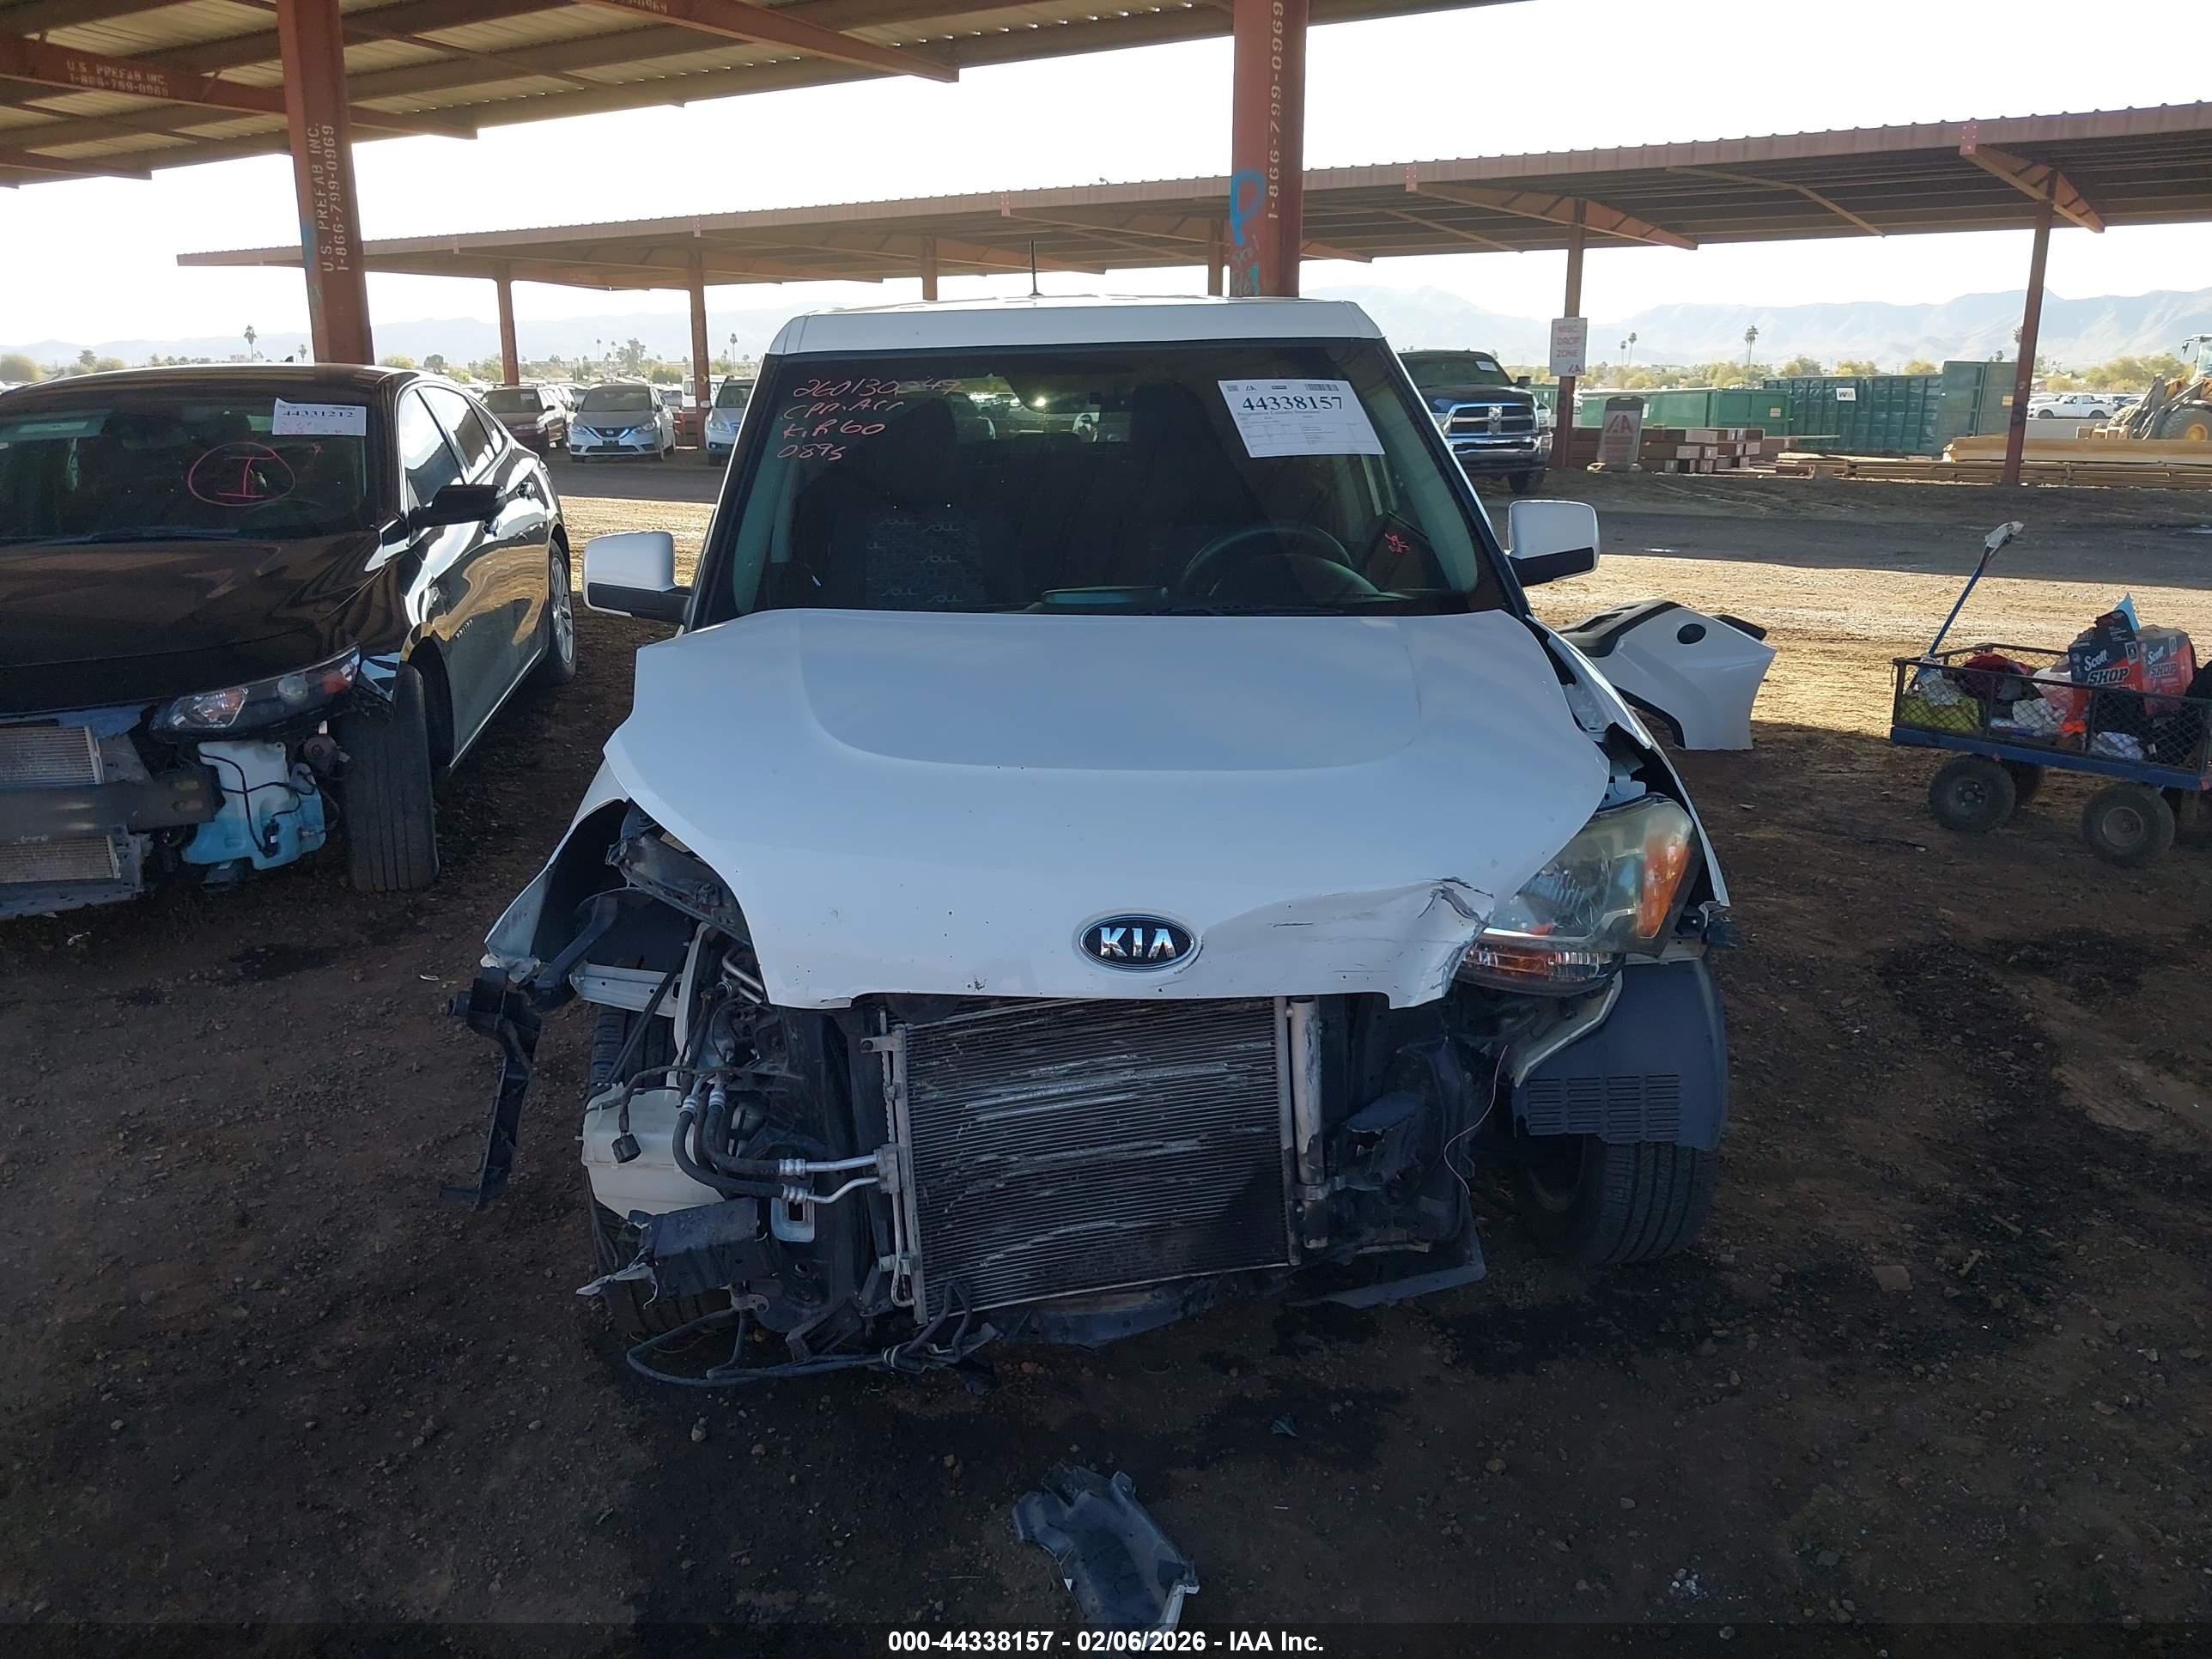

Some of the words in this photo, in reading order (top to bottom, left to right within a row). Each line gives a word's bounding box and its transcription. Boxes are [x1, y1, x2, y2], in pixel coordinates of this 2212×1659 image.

[95, 64, 143, 82] PREFAB
[307, 123, 323, 155] INC.
[311, 164, 331, 230] PREFAB
[321, 125, 350, 271] 1-866-799-0969
[1555, 349, 1579, 358] ZONE
[1243, 395, 1343, 411] 44338157
[2083, 648, 2109, 672] Scott
[2147, 645, 2165, 665] Scott
[2087, 666, 2130, 685] SHOP
[2149, 662, 2178, 678] SHOP
[1099, 927, 1177, 959] KIA
